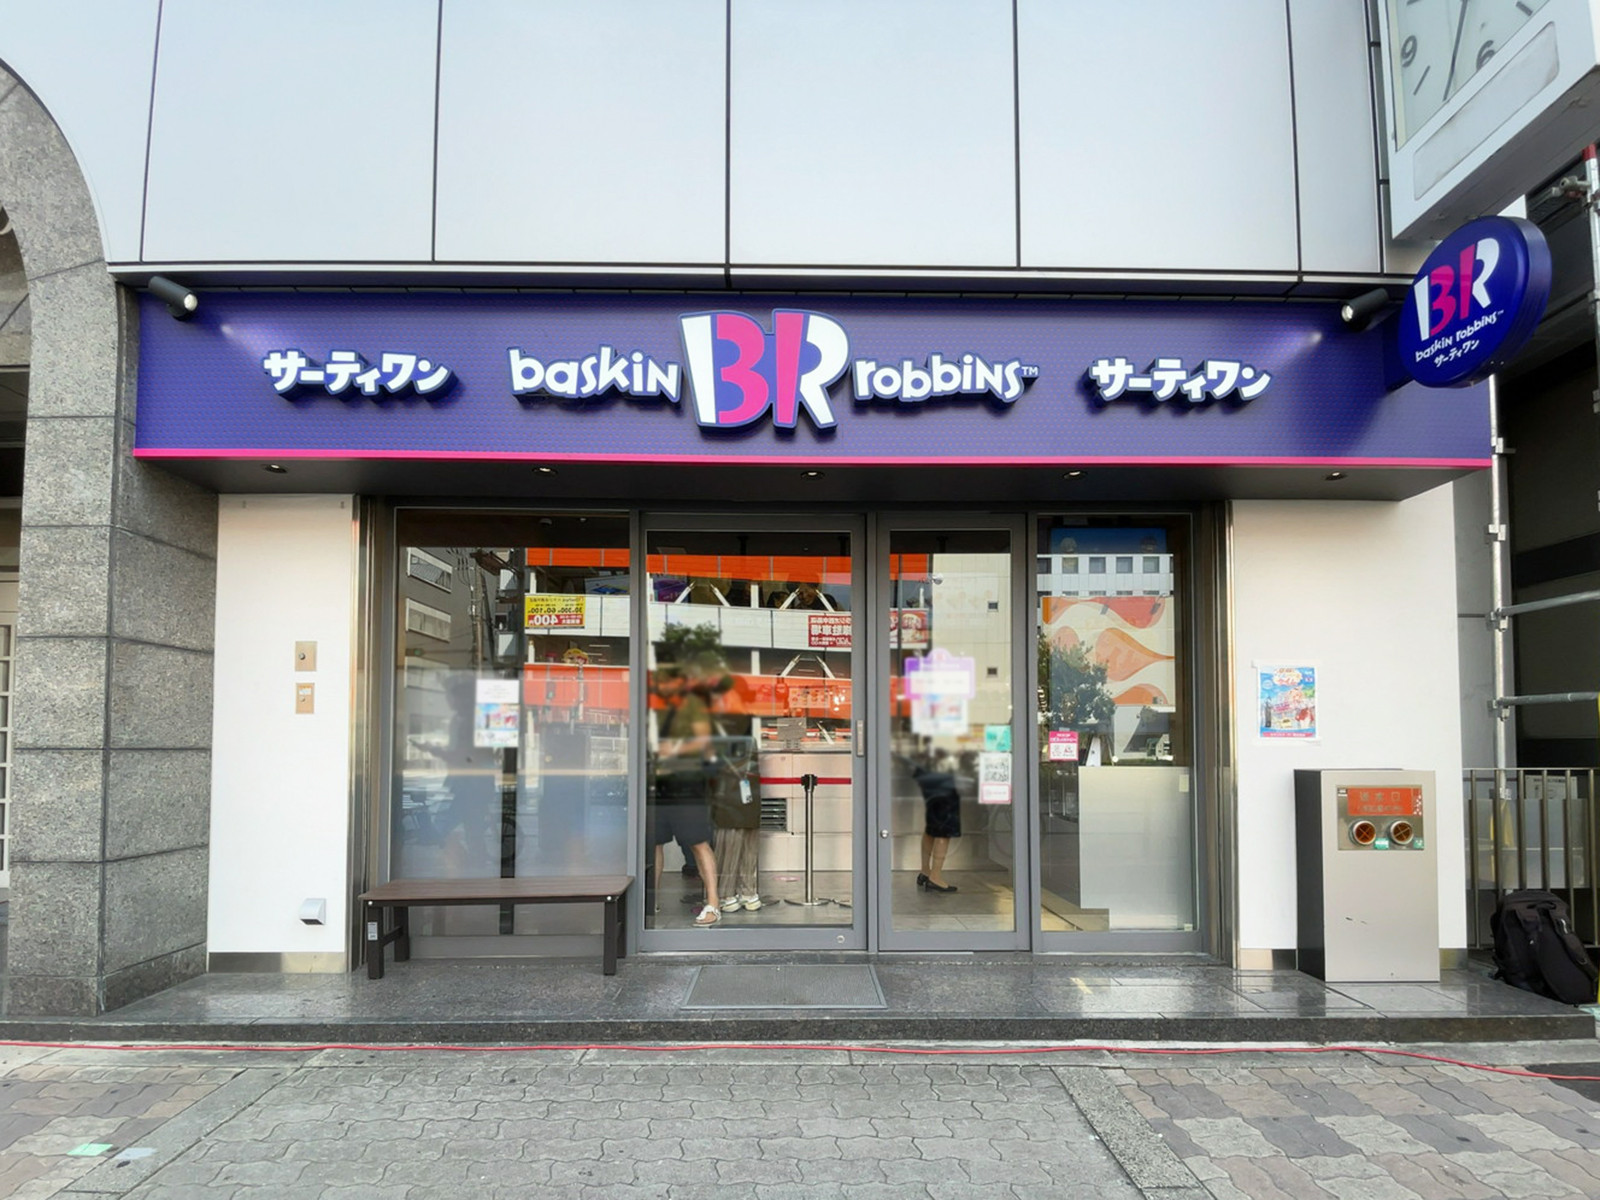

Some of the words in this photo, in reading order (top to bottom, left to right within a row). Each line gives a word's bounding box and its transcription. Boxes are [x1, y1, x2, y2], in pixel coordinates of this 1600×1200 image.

[1401, 35, 1417, 68] 9
[263, 351, 449, 393] サーティワン
[1434, 340, 1480, 367] サーティワン
[1092, 357, 1272, 399] サーティワン
